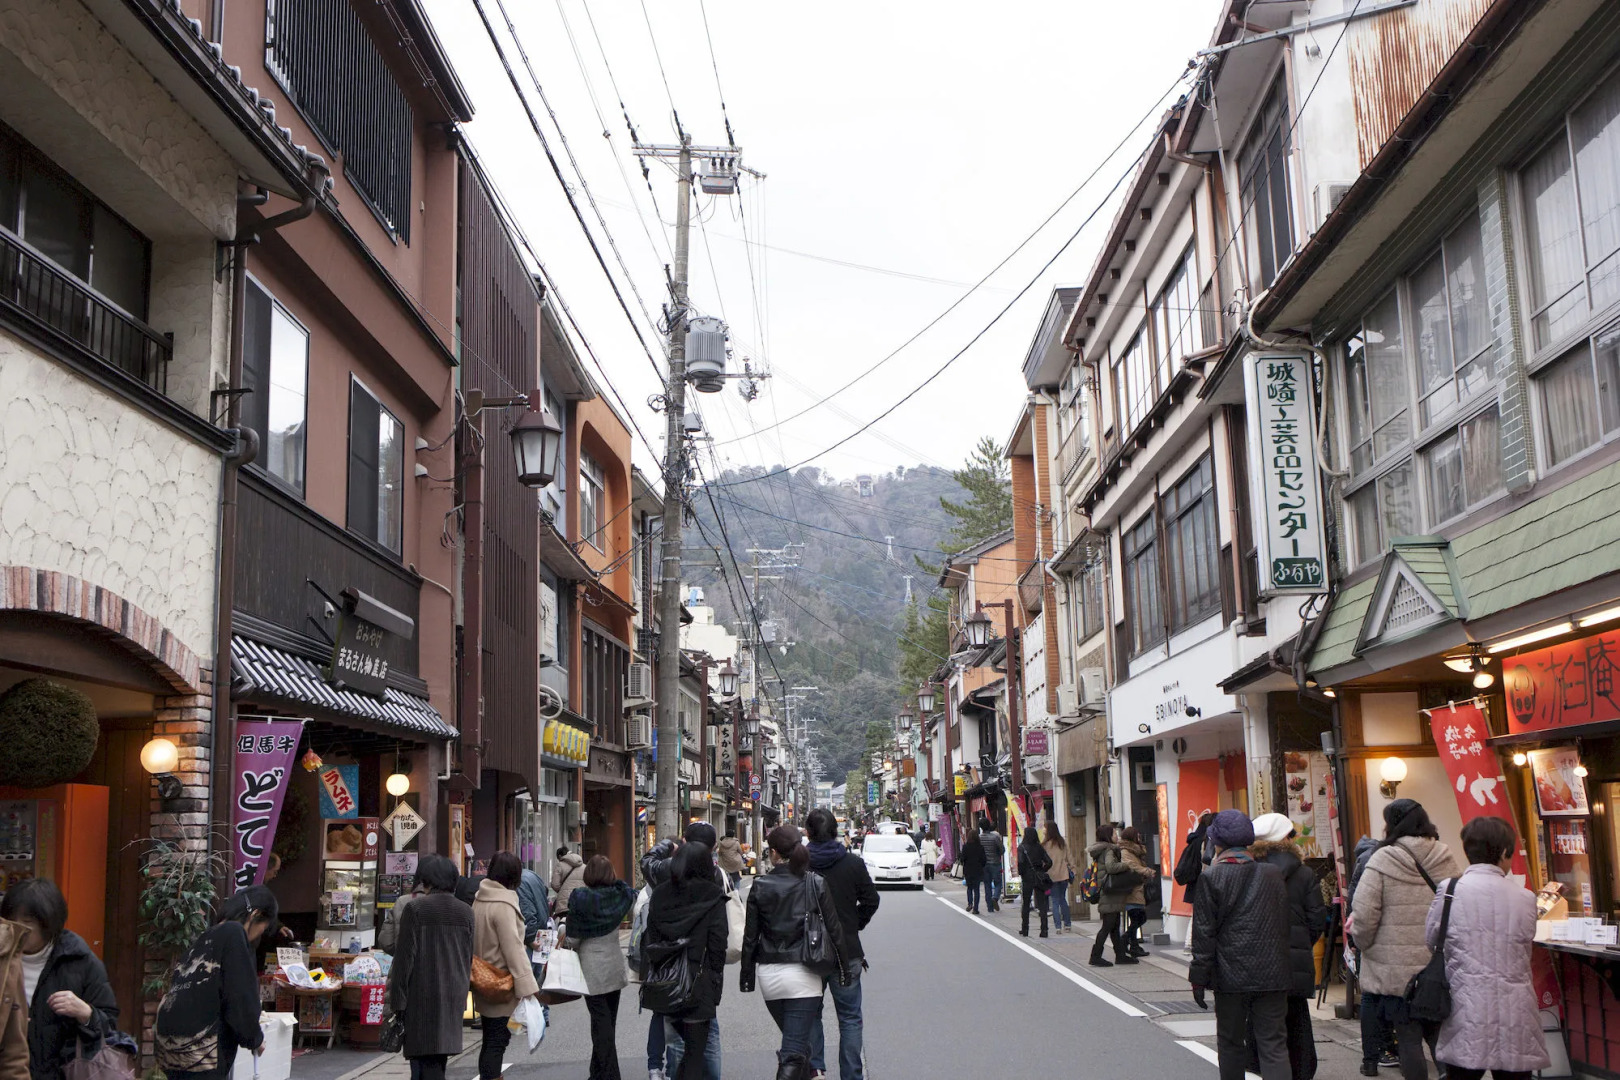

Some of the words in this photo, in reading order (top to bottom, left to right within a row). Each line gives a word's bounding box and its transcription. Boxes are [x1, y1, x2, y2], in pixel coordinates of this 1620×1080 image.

[1266, 362, 1308, 557] 城崎工芸品センター
[1274, 562, 1320, 584] ふるや
[355, 623, 384, 649] おみやげ
[338, 646, 388, 680] まるさん物産店
[1155, 695, 1188, 721] EBINOYA
[237, 735, 295, 754] 但馬牛
[721, 727, 732, 771] ちから餅
[324, 770, 352, 811] ラムネ
